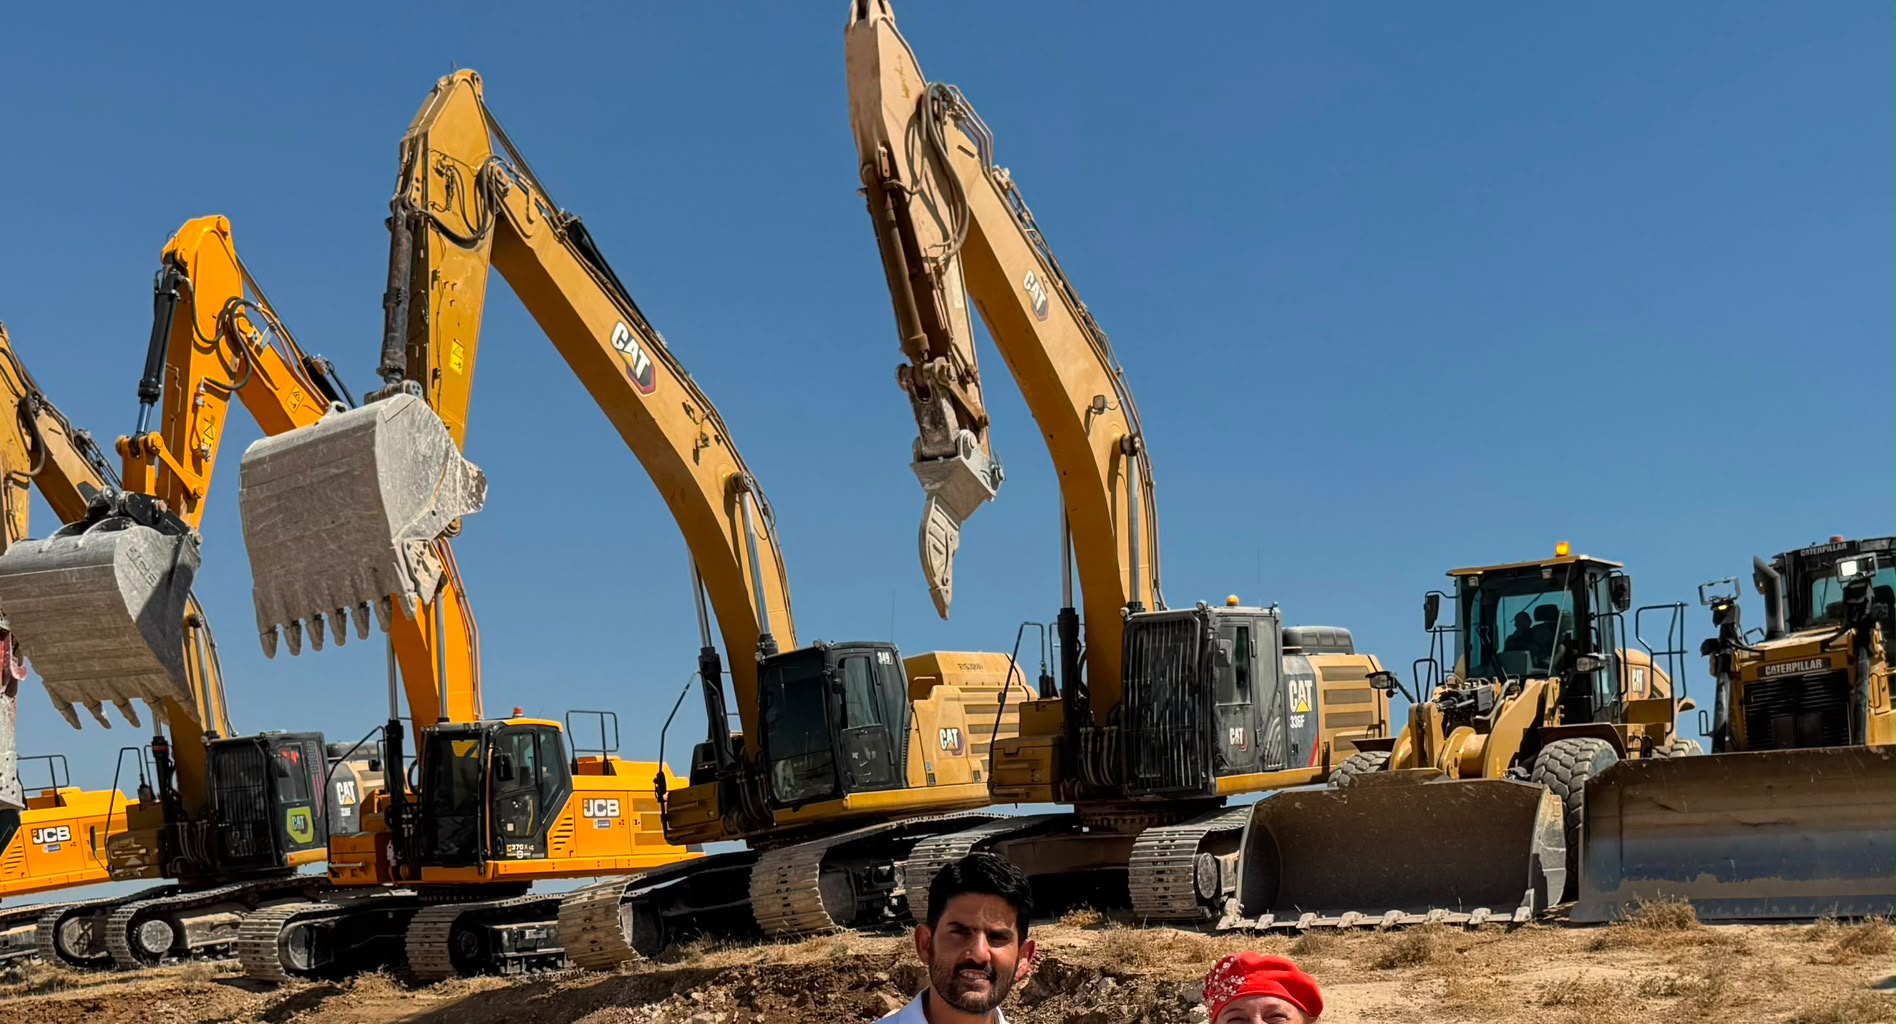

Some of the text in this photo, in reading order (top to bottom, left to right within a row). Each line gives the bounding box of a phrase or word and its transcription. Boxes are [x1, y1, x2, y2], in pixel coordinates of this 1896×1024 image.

[1023, 270, 1046, 311] CAT
[611, 321, 651, 379] CAT
[1800, 543, 1847, 557] CATERPILLAR
[877, 651, 890, 665] 349
[1765, 659, 1822, 676] CATERPILLAR
[1632, 669, 1643, 692] CAT
[1289, 680, 1313, 713] CAT
[939, 728, 958, 750] CAT
[1230, 727, 1244, 745] CAT
[336, 781, 356, 805] CAT
[583, 799, 620, 818] JCB
[292, 815, 305, 830] CAT
[31, 826, 71, 844] JCB
